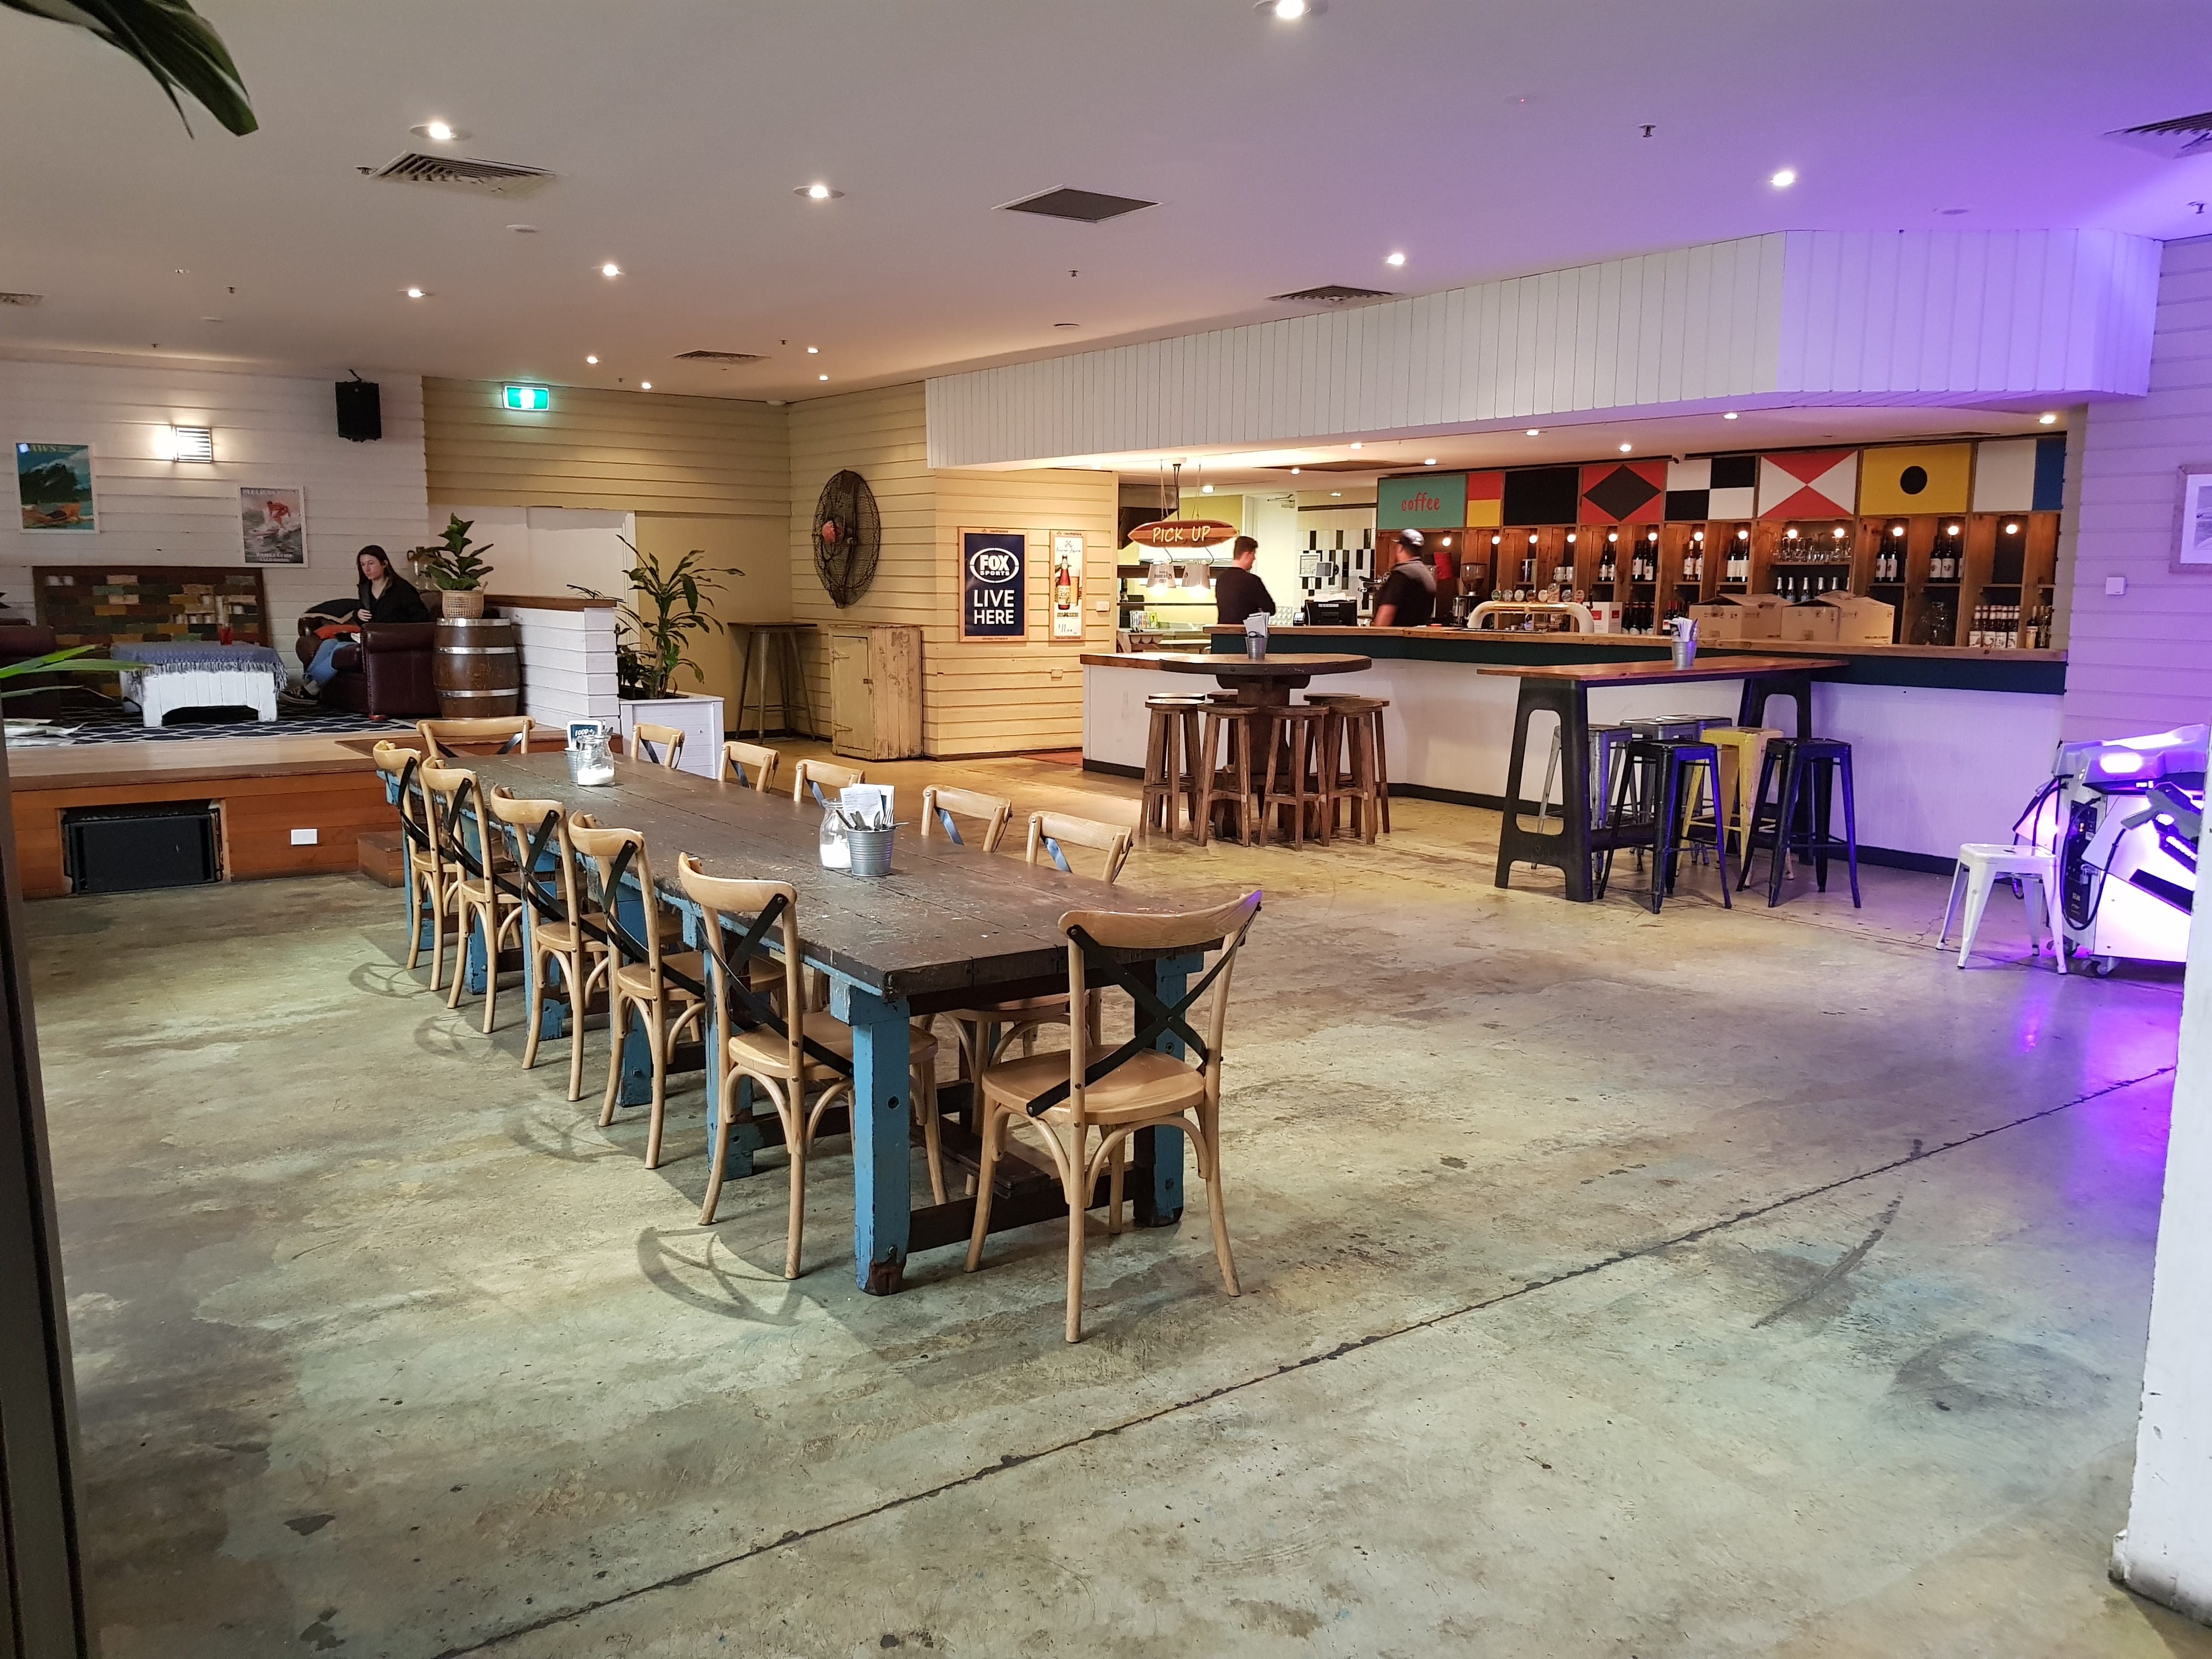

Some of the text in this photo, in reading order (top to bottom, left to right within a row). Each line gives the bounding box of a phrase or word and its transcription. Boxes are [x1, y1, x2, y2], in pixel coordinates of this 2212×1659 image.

[1401, 492, 1440, 511] coffee
[1152, 526, 1211, 543] PICK UP
[980, 555, 1010, 571] FOX
[974, 589, 1015, 607] LIVE
[974, 610, 1015, 624] HERE
